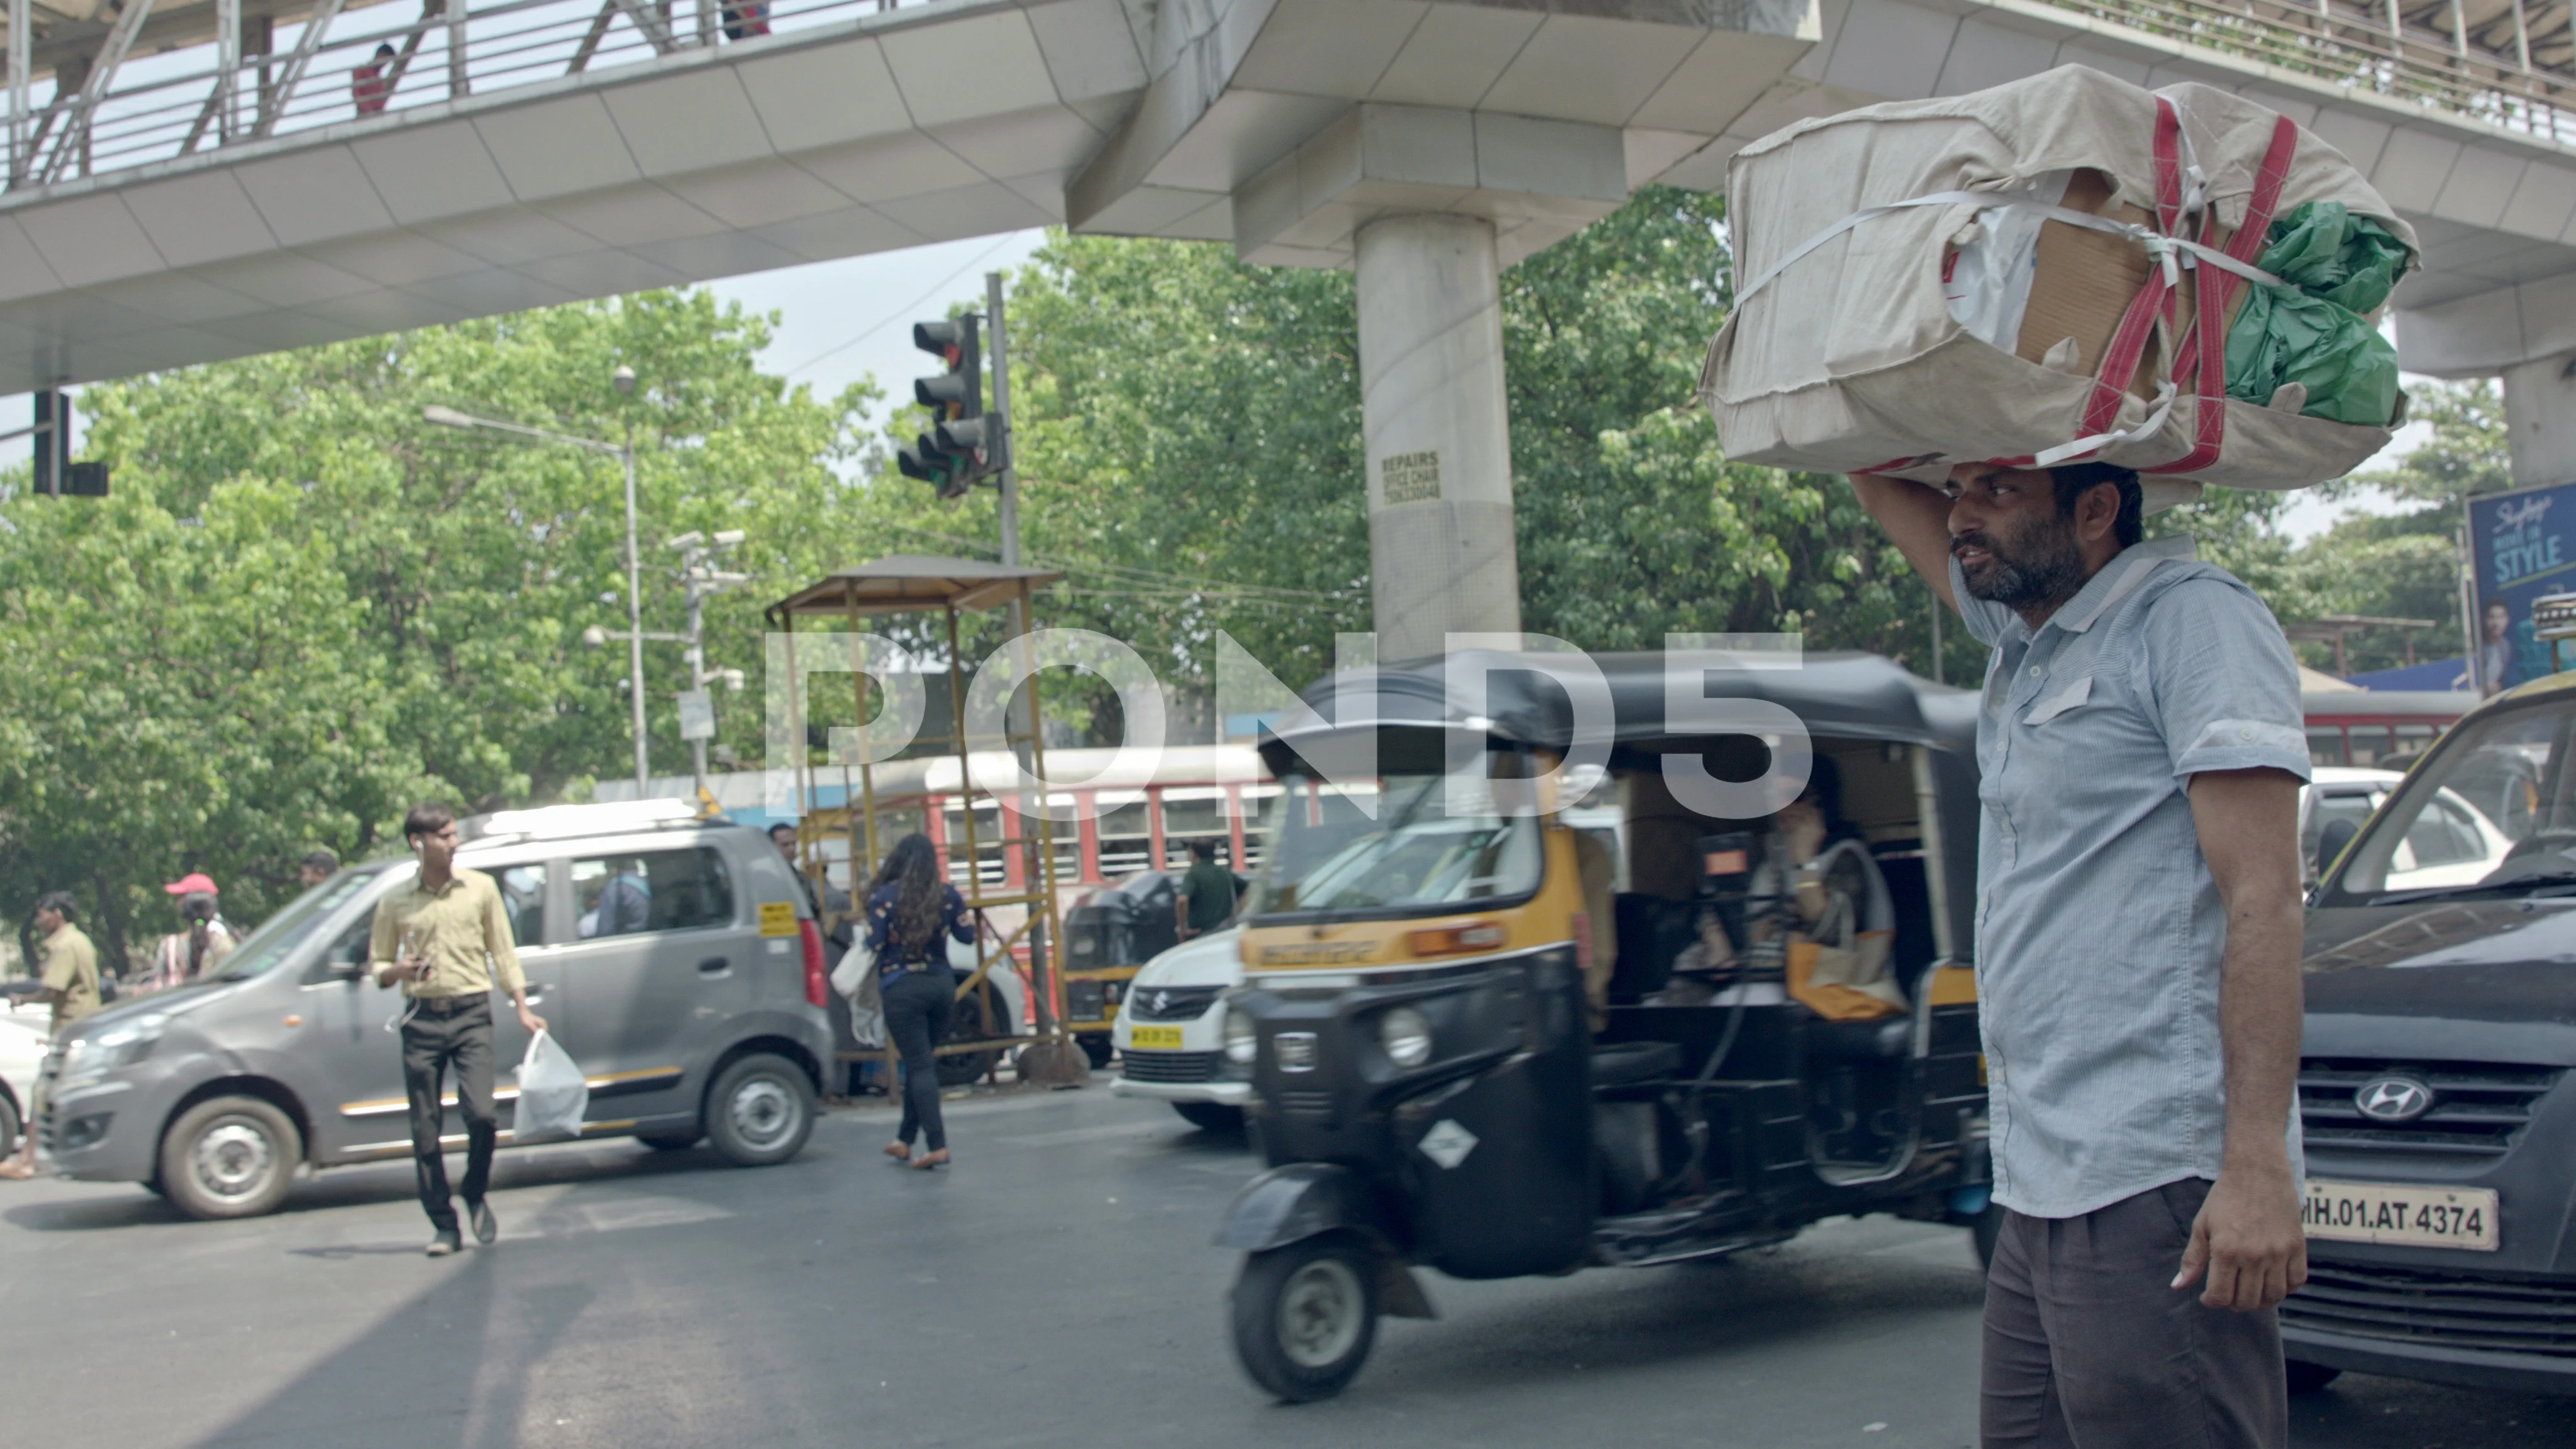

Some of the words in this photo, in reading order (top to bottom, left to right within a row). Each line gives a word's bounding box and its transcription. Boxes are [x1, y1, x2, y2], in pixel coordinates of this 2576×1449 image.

[1382, 451, 1438, 472] REPAIRS
[2494, 534, 2563, 583] STYLE
[2416, 1204, 2482, 1236] 4374
